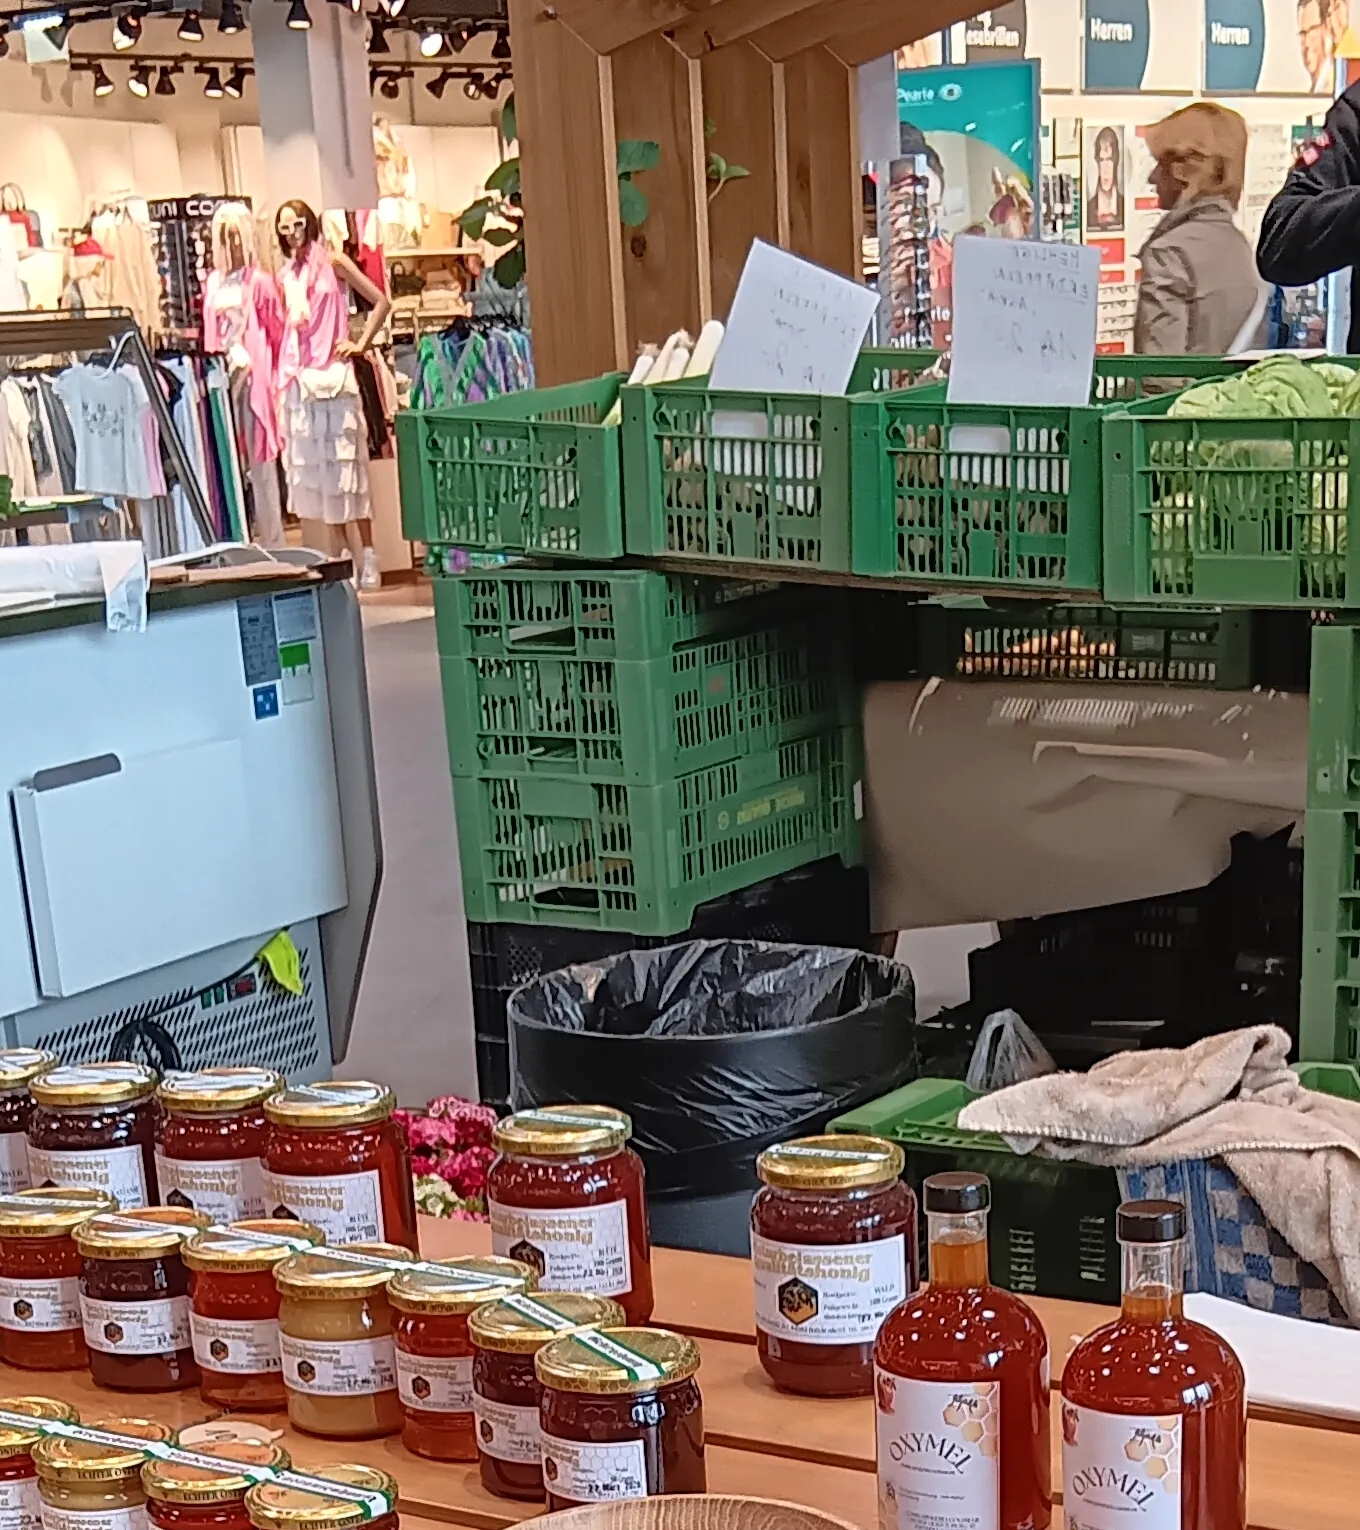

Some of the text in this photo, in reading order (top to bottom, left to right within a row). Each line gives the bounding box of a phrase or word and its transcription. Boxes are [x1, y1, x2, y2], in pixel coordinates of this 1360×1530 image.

[1090, 17, 1133, 42] Herren
[1211, 22, 1250, 46] Herren
[889, 1432, 972, 1475] OXYMEL
[1072, 1466, 1155, 1513] OXYMEL
